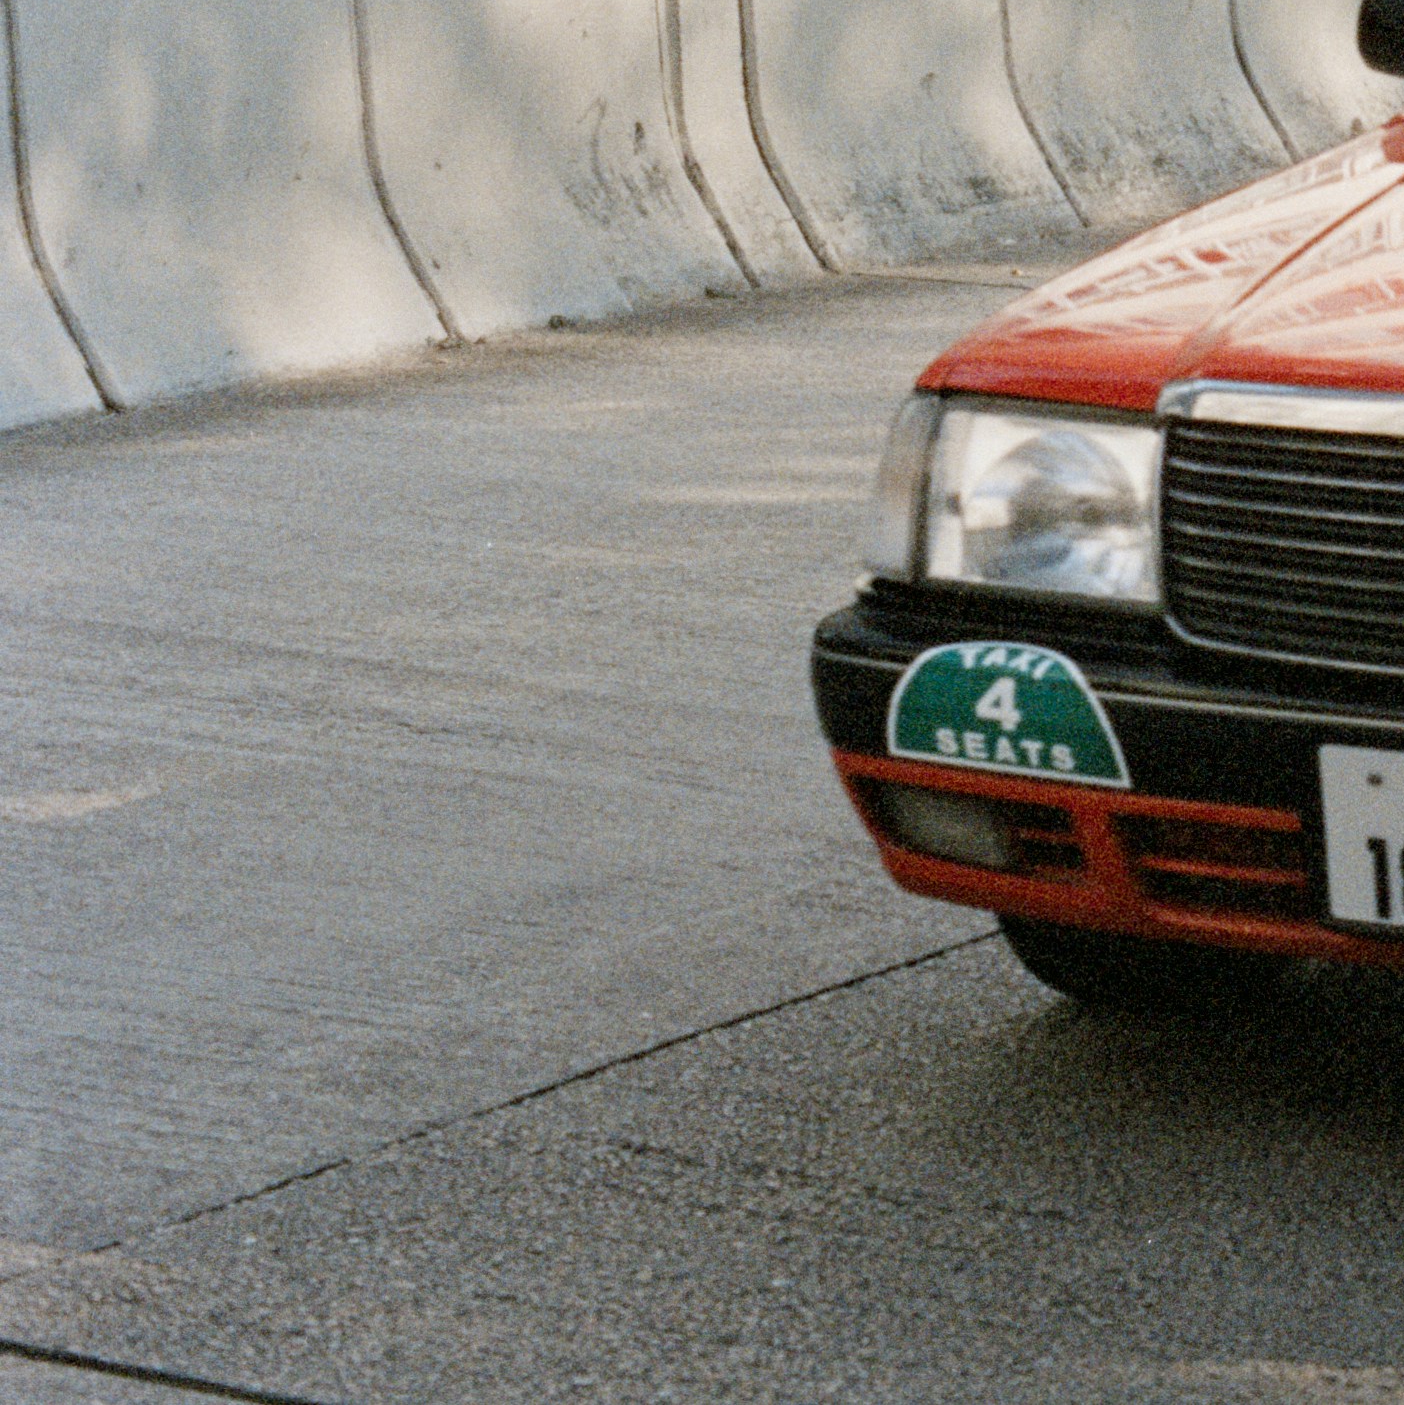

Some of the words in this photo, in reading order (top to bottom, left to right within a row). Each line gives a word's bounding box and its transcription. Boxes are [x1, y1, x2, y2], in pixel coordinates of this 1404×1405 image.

[959, 647, 1053, 680] TAXI
[974, 677, 1021, 731] 4
[935, 727, 1076, 771] SEATS
